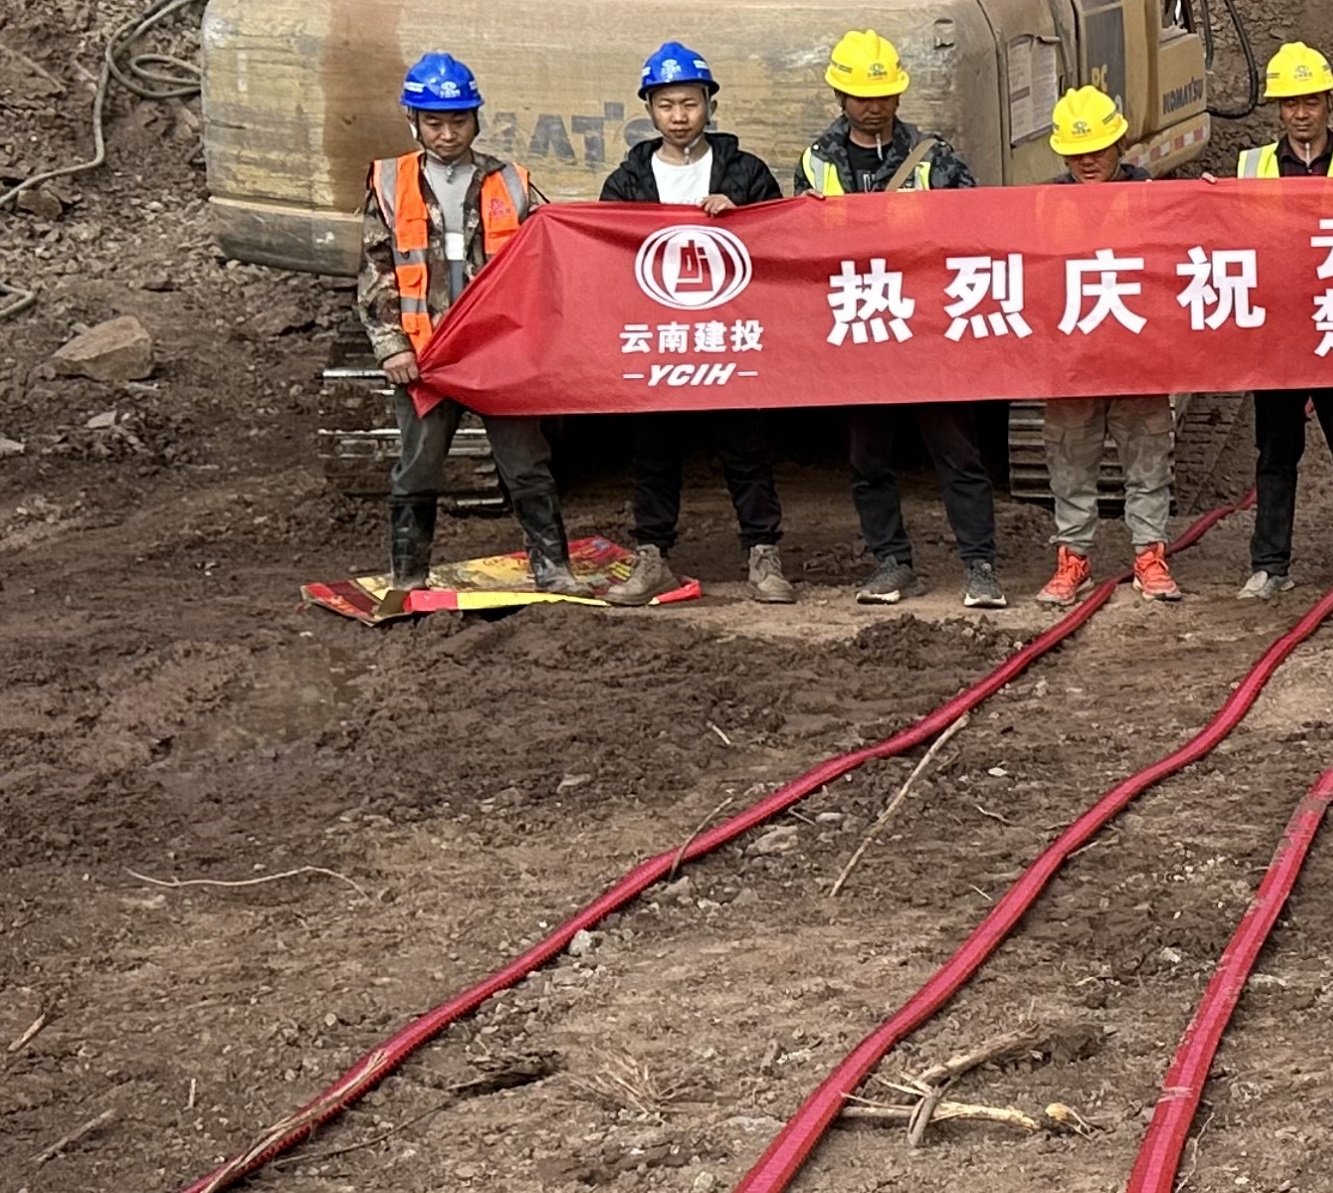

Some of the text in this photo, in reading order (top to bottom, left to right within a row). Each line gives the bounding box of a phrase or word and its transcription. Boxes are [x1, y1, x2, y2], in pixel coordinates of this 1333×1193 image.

[1162, 76, 1205, 115] KOMATSU
[825, 245, 1267, 347] 热烈庆祝
[619, 319, 765, 354] 云南建投
[647, 362, 737, 388] YCIH
